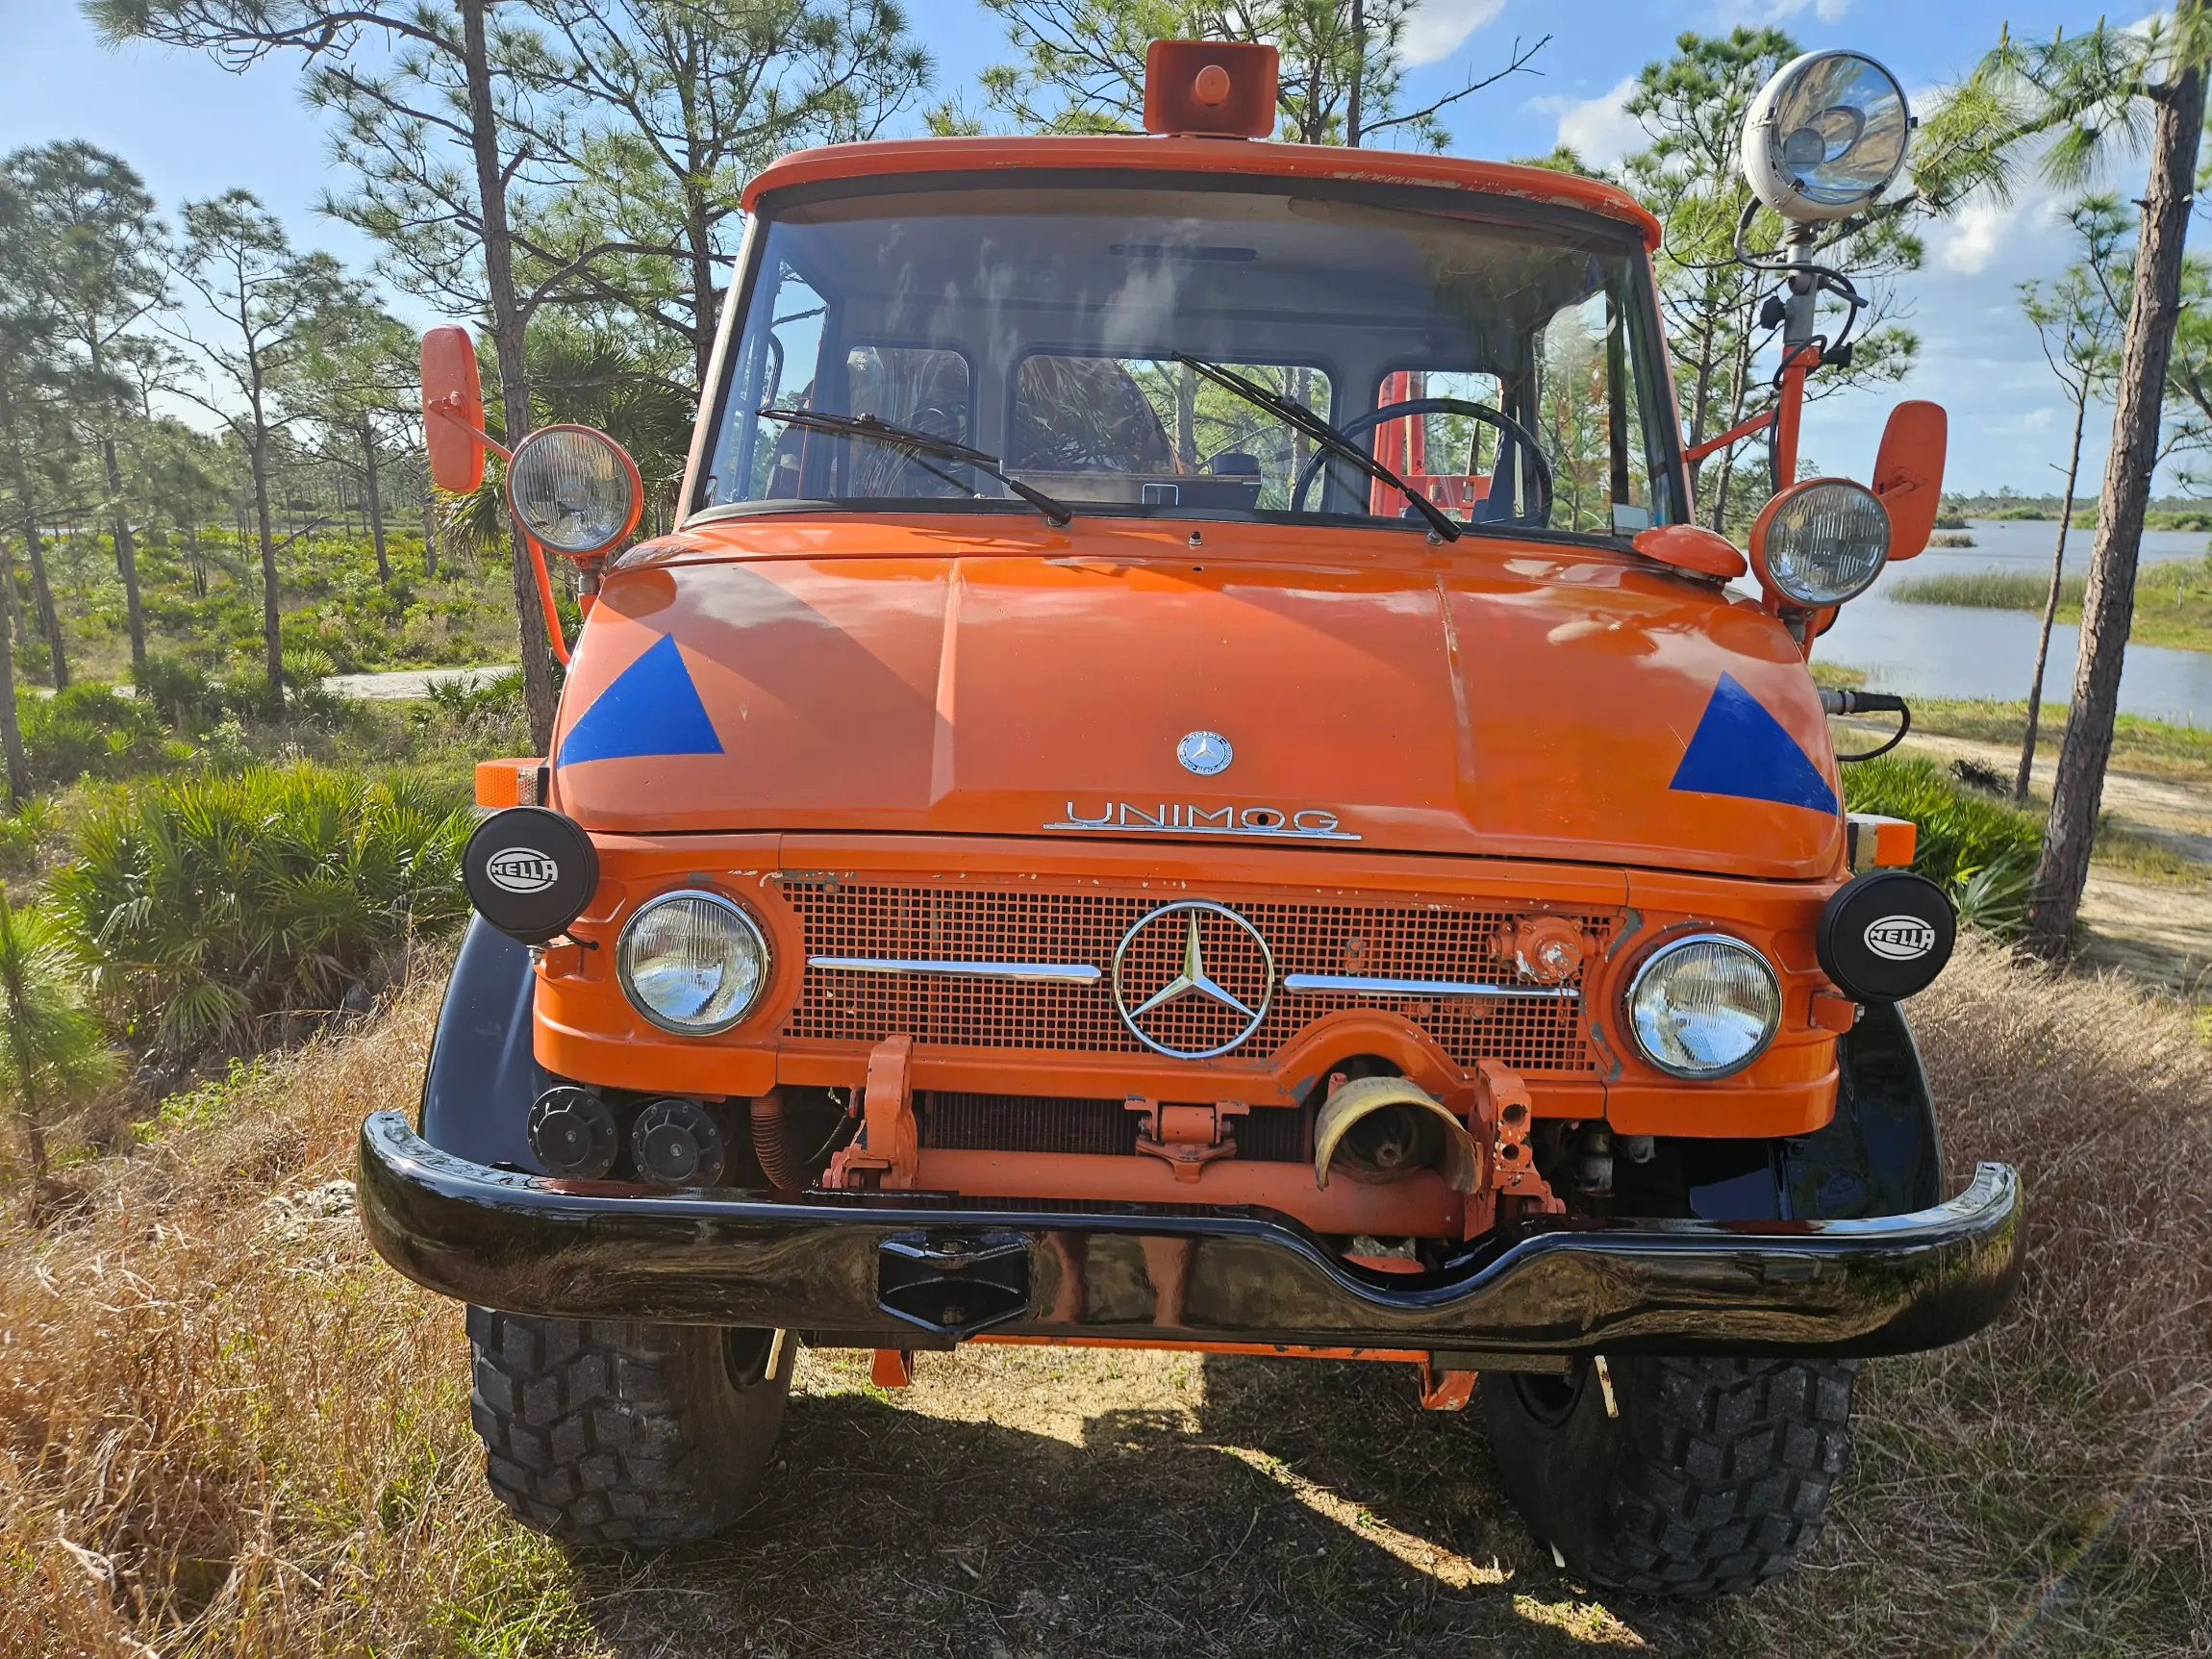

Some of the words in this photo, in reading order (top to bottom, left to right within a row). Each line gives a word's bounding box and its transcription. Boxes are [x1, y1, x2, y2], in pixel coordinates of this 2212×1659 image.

[1067, 801, 1339, 833] UNIMOG
[490, 859, 559, 882] HELLA
[1870, 928, 1936, 951] HELLA
